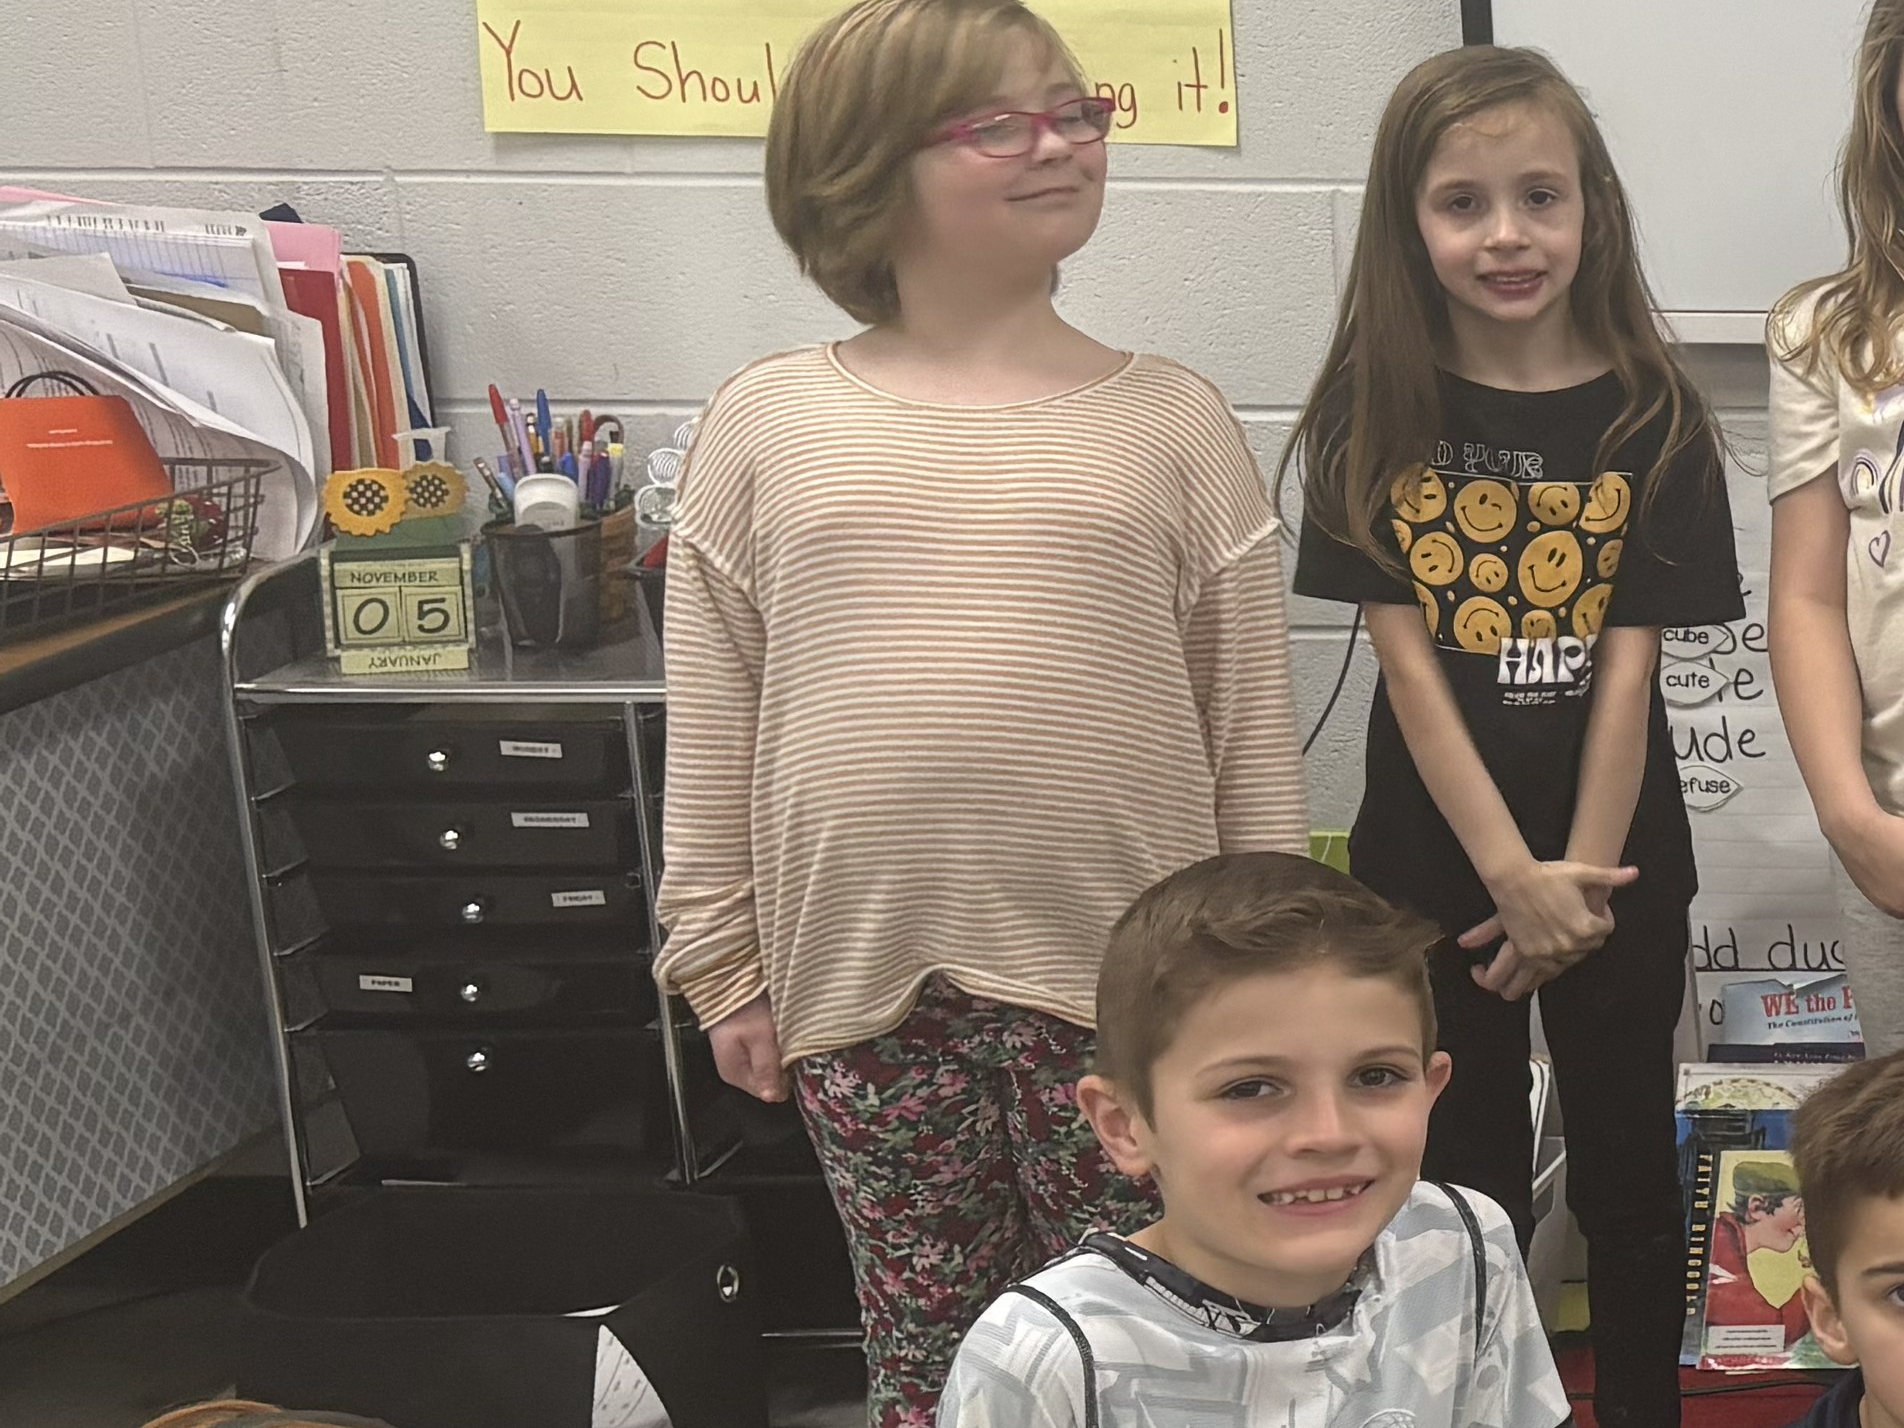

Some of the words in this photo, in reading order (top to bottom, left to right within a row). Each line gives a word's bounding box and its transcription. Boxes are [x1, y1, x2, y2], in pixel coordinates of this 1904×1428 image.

[483, 20, 583, 103] You
[1171, 29, 1231, 114] it!
[350, 571, 440, 585] NOVEMBER
[1663, 628, 1709, 644] cube
[368, 653, 442, 668] JANUARY
[1666, 673, 1710, 688] cute
[1761, 991, 1800, 1018] WE
[1805, 993, 1837, 1014] the
